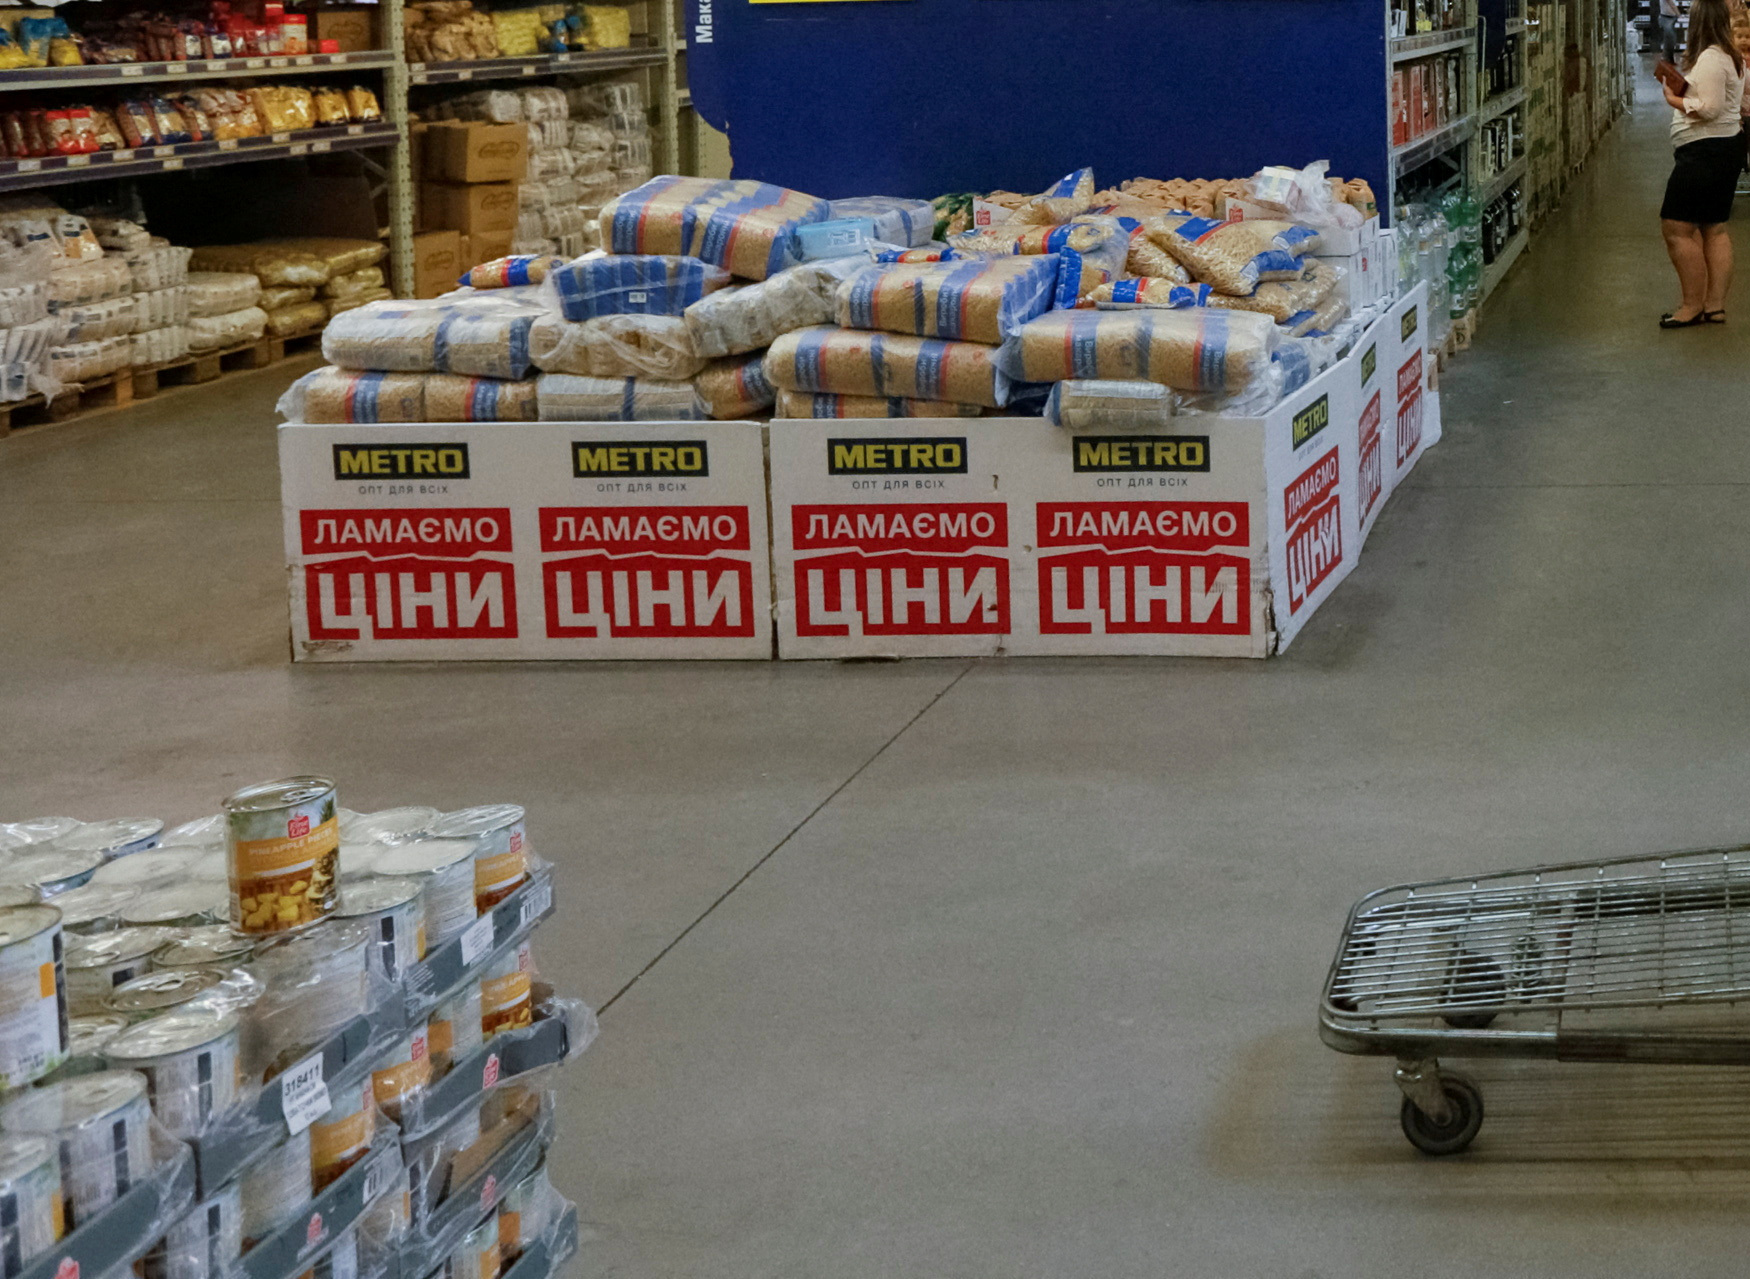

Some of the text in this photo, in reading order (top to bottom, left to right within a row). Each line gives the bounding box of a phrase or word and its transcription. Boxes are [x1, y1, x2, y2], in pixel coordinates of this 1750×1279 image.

[1293, 402, 1328, 446] METRO
[339, 447, 464, 475] METRO
[577, 445, 703, 473] METRO
[833, 443, 962, 470] METRO
[1079, 441, 1204, 467] METRO
[358, 484, 450, 497] ОПТ ДЛЯ ВСІХ
[596, 482, 687, 494] ОПТ ДЛЯ ВСІХ
[852, 479, 946, 491] ОПТ ДЛЯ ВСІХ
[1096, 477, 1188, 489] ОПТ ДЛЯ ВСІХ
[1287, 456, 1338, 520] ЛАМАЄМО
[314, 516, 500, 545] ЛАМАЄМО
[553, 515, 737, 542] ЛАМАЄМО
[805, 511, 996, 540] ЛАМАЄМО
[1049, 510, 1237, 538] ЛАМАЄМО
[1287, 503, 1340, 604] ЦІНИ
[318, 570, 506, 640] ЦІНИ
[555, 569, 742, 638] ЦІНИ
[807, 566, 998, 637] ЦІНИ
[1051, 565, 1238, 635] ЦІНИ
[249, 838, 306, 857] PINEAPPLE
[284, 1063, 320, 1097] 318411
